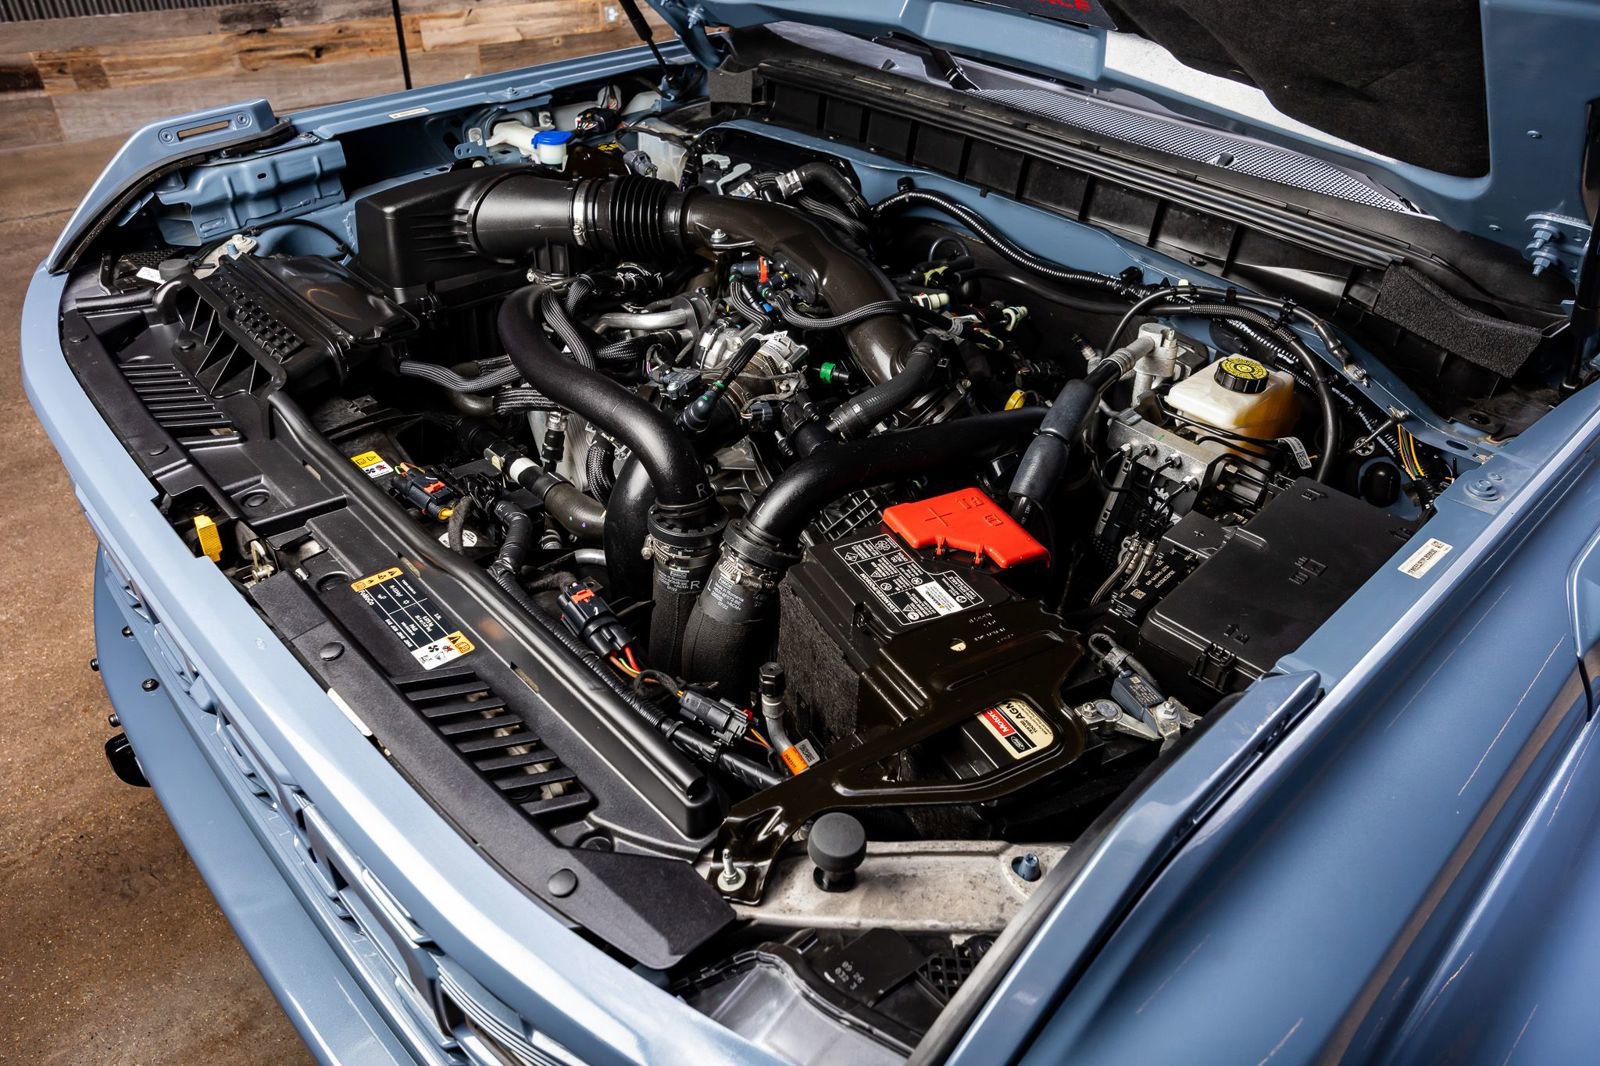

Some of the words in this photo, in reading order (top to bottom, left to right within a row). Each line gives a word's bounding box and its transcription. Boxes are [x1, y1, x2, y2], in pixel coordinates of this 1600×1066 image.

[696, 483, 706, 498] R
[690, 580, 701, 590] R
[987, 710, 1009, 733] Motorc
